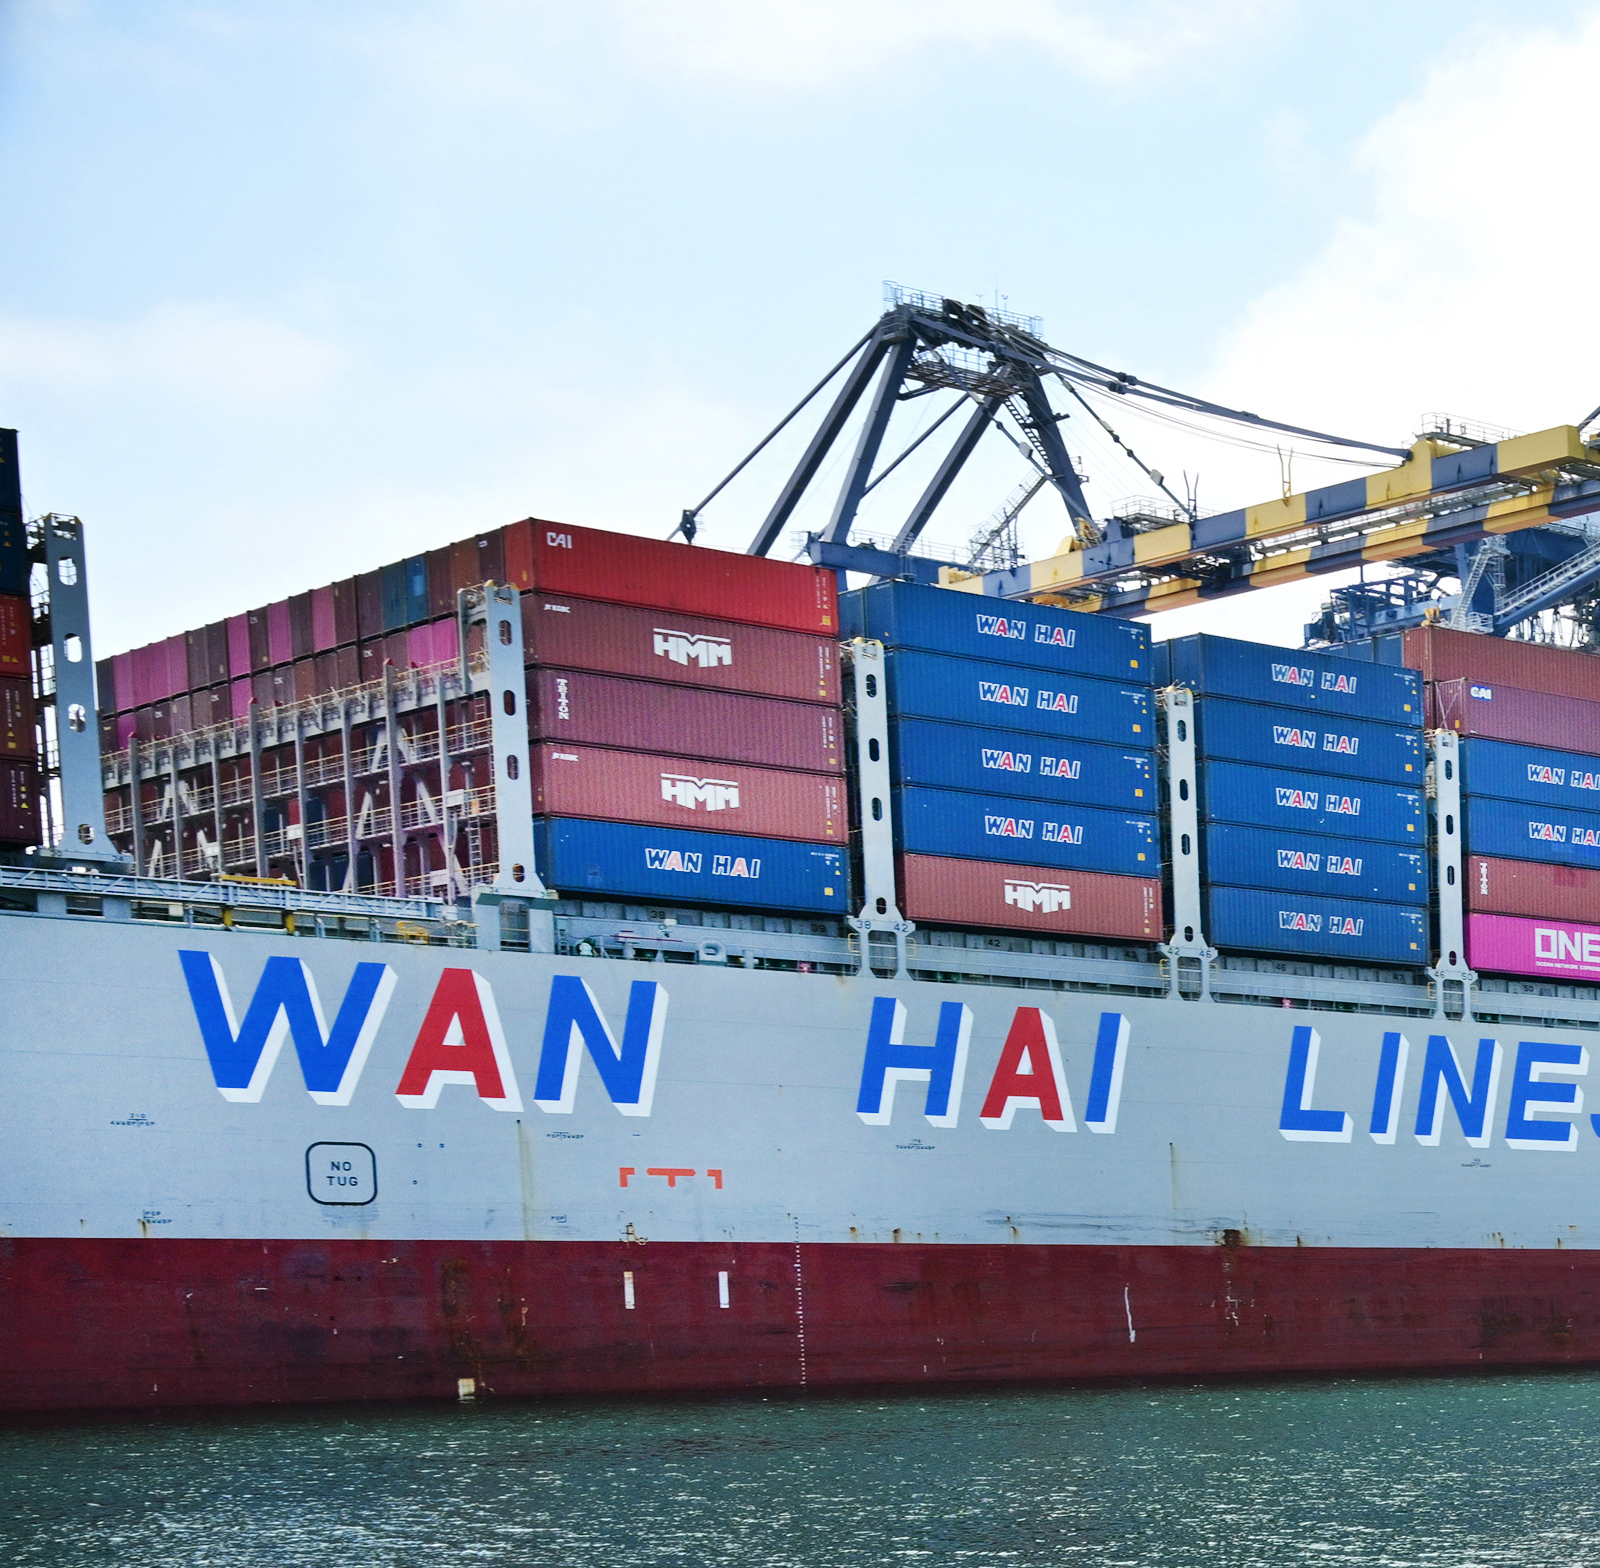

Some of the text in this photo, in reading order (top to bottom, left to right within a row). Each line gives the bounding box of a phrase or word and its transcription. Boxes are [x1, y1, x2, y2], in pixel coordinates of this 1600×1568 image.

[546, 531, 573, 549] CAI
[976, 614, 1076, 648] WAN HAI
[653, 633, 732, 668] HMM
[1271, 664, 1357, 694] WAN HAI
[1469, 685, 1492, 700] CAI
[556, 678, 570, 720] TRITON
[979, 681, 1078, 713] WAN HAI
[1273, 726, 1359, 754] WAN HAI
[982, 749, 1081, 780] WAN HAI
[1528, 764, 1565, 785] WAN
[660, 778, 740, 812] HMM
[1276, 788, 1361, 815] WAN HAI
[984, 815, 1083, 844] WAN HAI
[1529, 822, 1567, 843] WAN
[645, 848, 760, 879] WAN HAI
[1277, 850, 1362, 876] WAN HAI
[1003, 884, 1071, 914] HMM
[856, 920, 872, 929] 38
[893, 923, 908, 933] 42
[1279, 911, 1364, 936] WAN HAI
[1199, 949, 1213, 959] 46
[1434, 970, 1446, 979] 46
[178, 949, 669, 1117] WAN
[856, 997, 1131, 1135] HAI
[330, 1161, 352, 1172] NO
[326, 1176, 359, 1187] TUG
